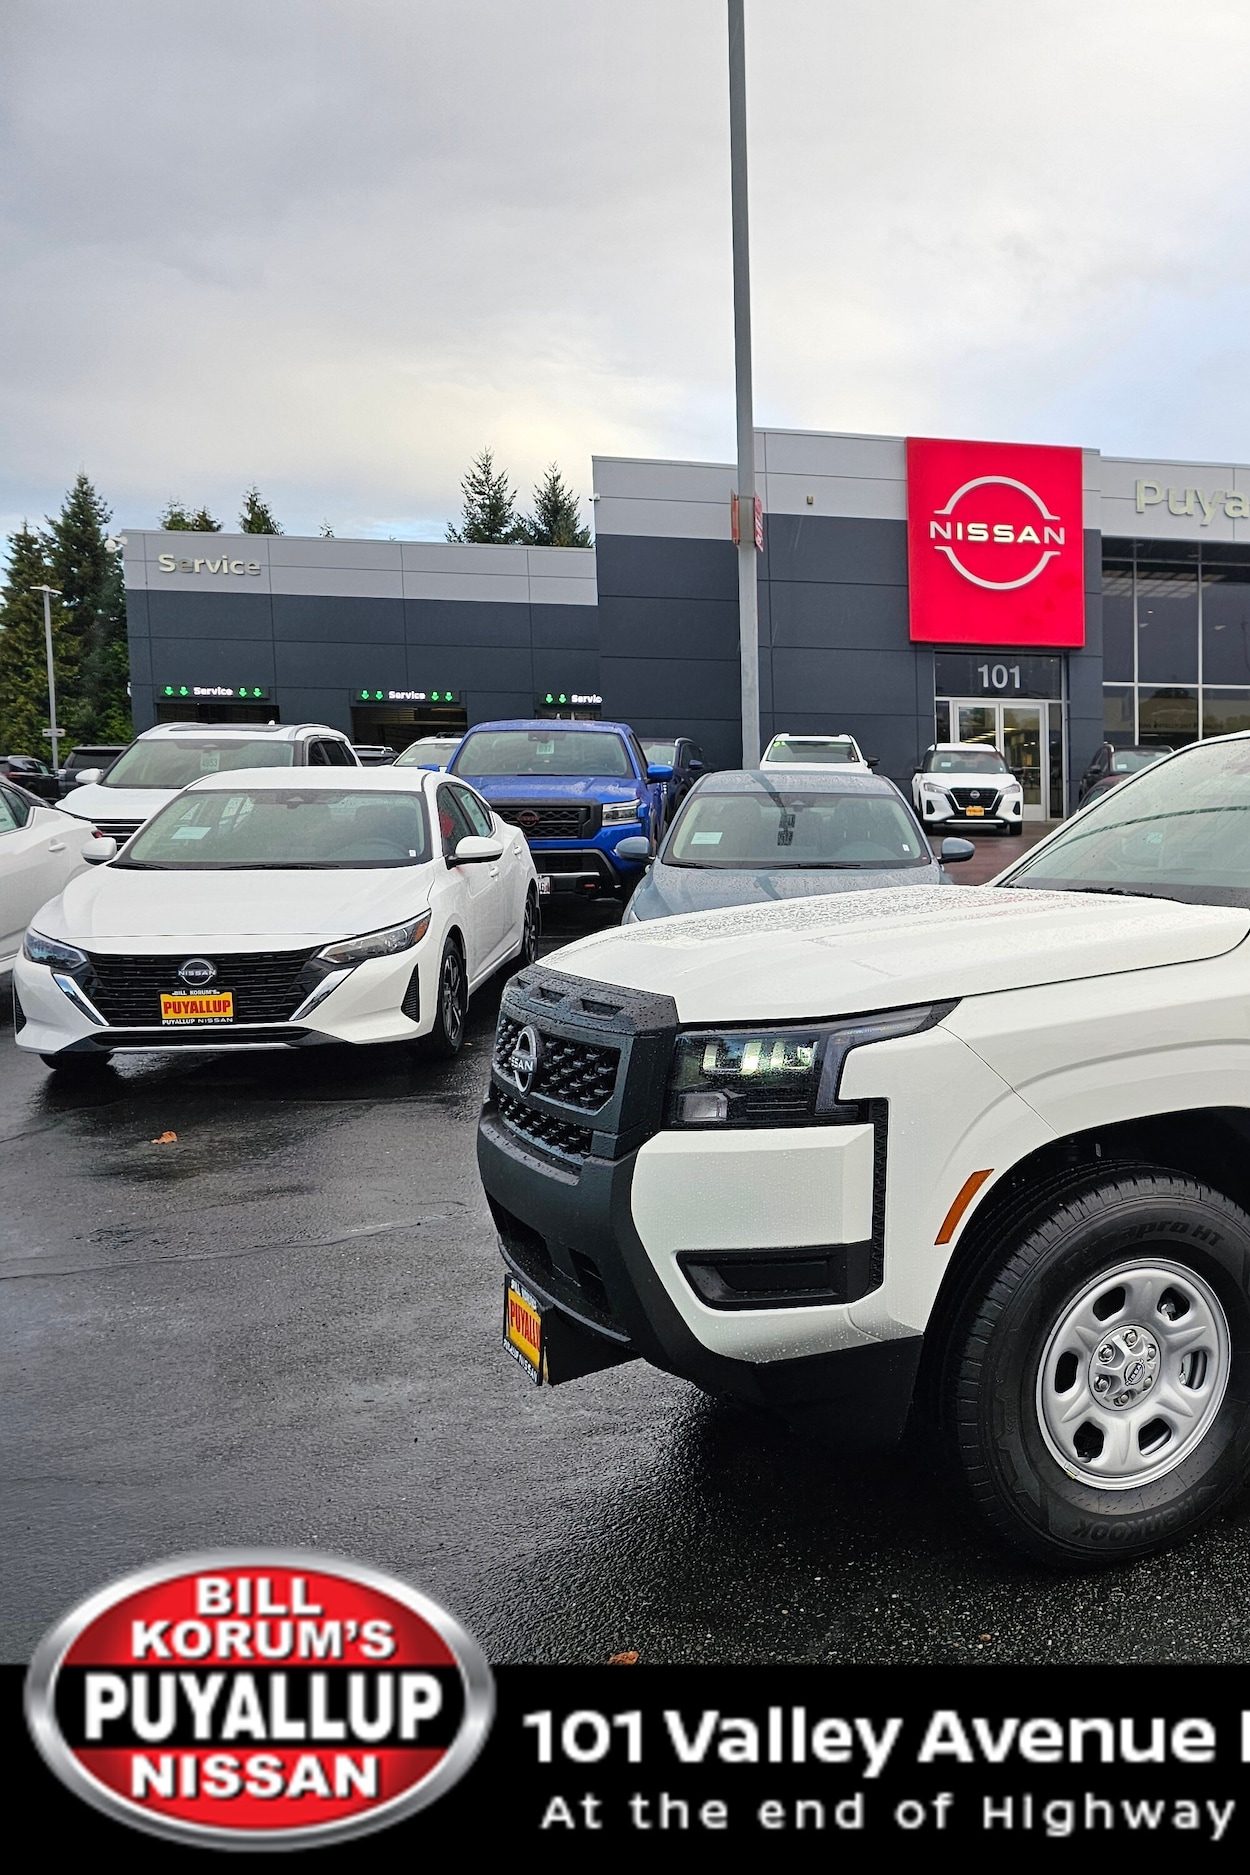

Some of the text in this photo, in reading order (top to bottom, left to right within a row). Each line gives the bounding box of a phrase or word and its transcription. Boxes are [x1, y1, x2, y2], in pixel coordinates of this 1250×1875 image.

[929, 521, 1066, 545] NISSAN
[158, 553, 261, 576] Service
[978, 664, 1021, 689] 101
[193, 686, 234, 696] Service
[388, 690, 426, 700] Service
[571, 694, 603, 704] Servic
[163, 1000, 231, 1015] PUYALLUP
